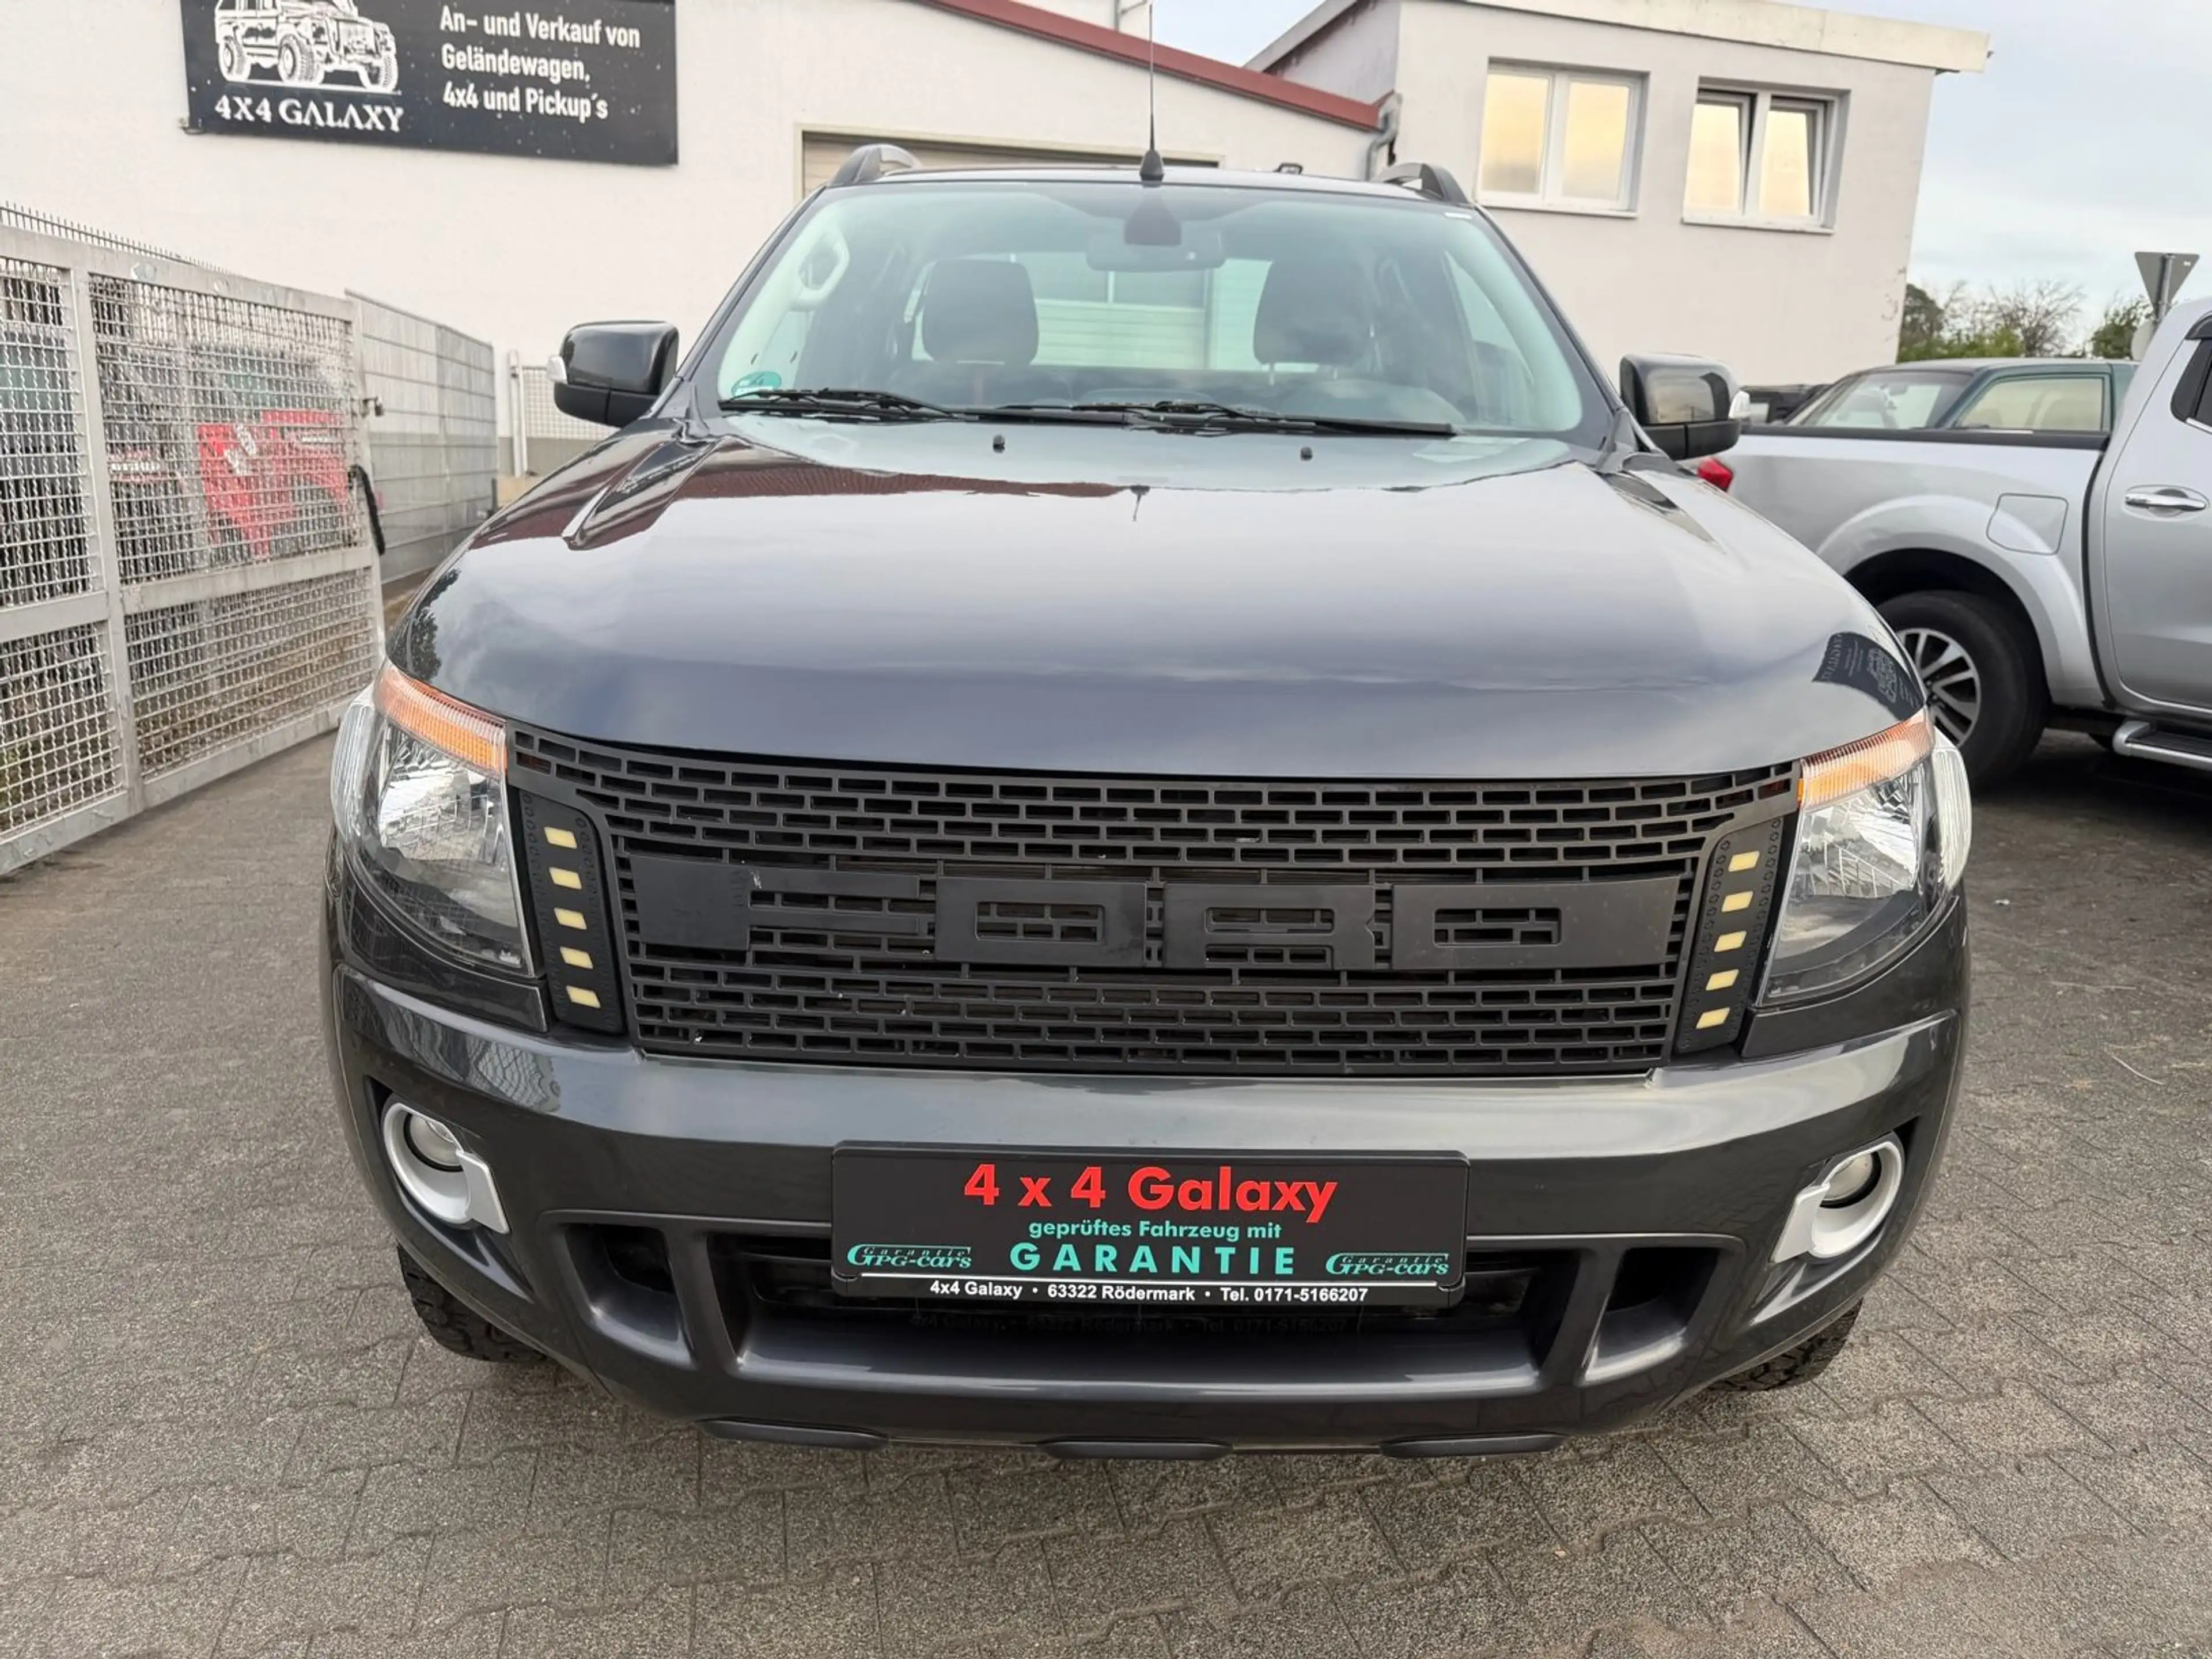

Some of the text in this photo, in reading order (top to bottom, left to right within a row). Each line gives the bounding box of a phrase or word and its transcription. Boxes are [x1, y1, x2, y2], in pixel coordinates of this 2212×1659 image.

[440, 5, 641, 48] An- und Verkauf von
[441, 43, 590, 84] Geländewagen,
[215, 94, 403, 132] 4X4 GALAXY
[442, 81, 479, 108] 4x4
[483, 86, 520, 112] und
[965, 1164, 1338, 1224] 4 x 4 Galaxy
[1028, 1219, 1282, 1243] geprüftes Fahrzeug mit
[1010, 1243, 1294, 1275] GARANTIE
[930, 1280, 1368, 1302] 4x4 Galaxy 63322 Rödermark Tel. 0171-5166207
